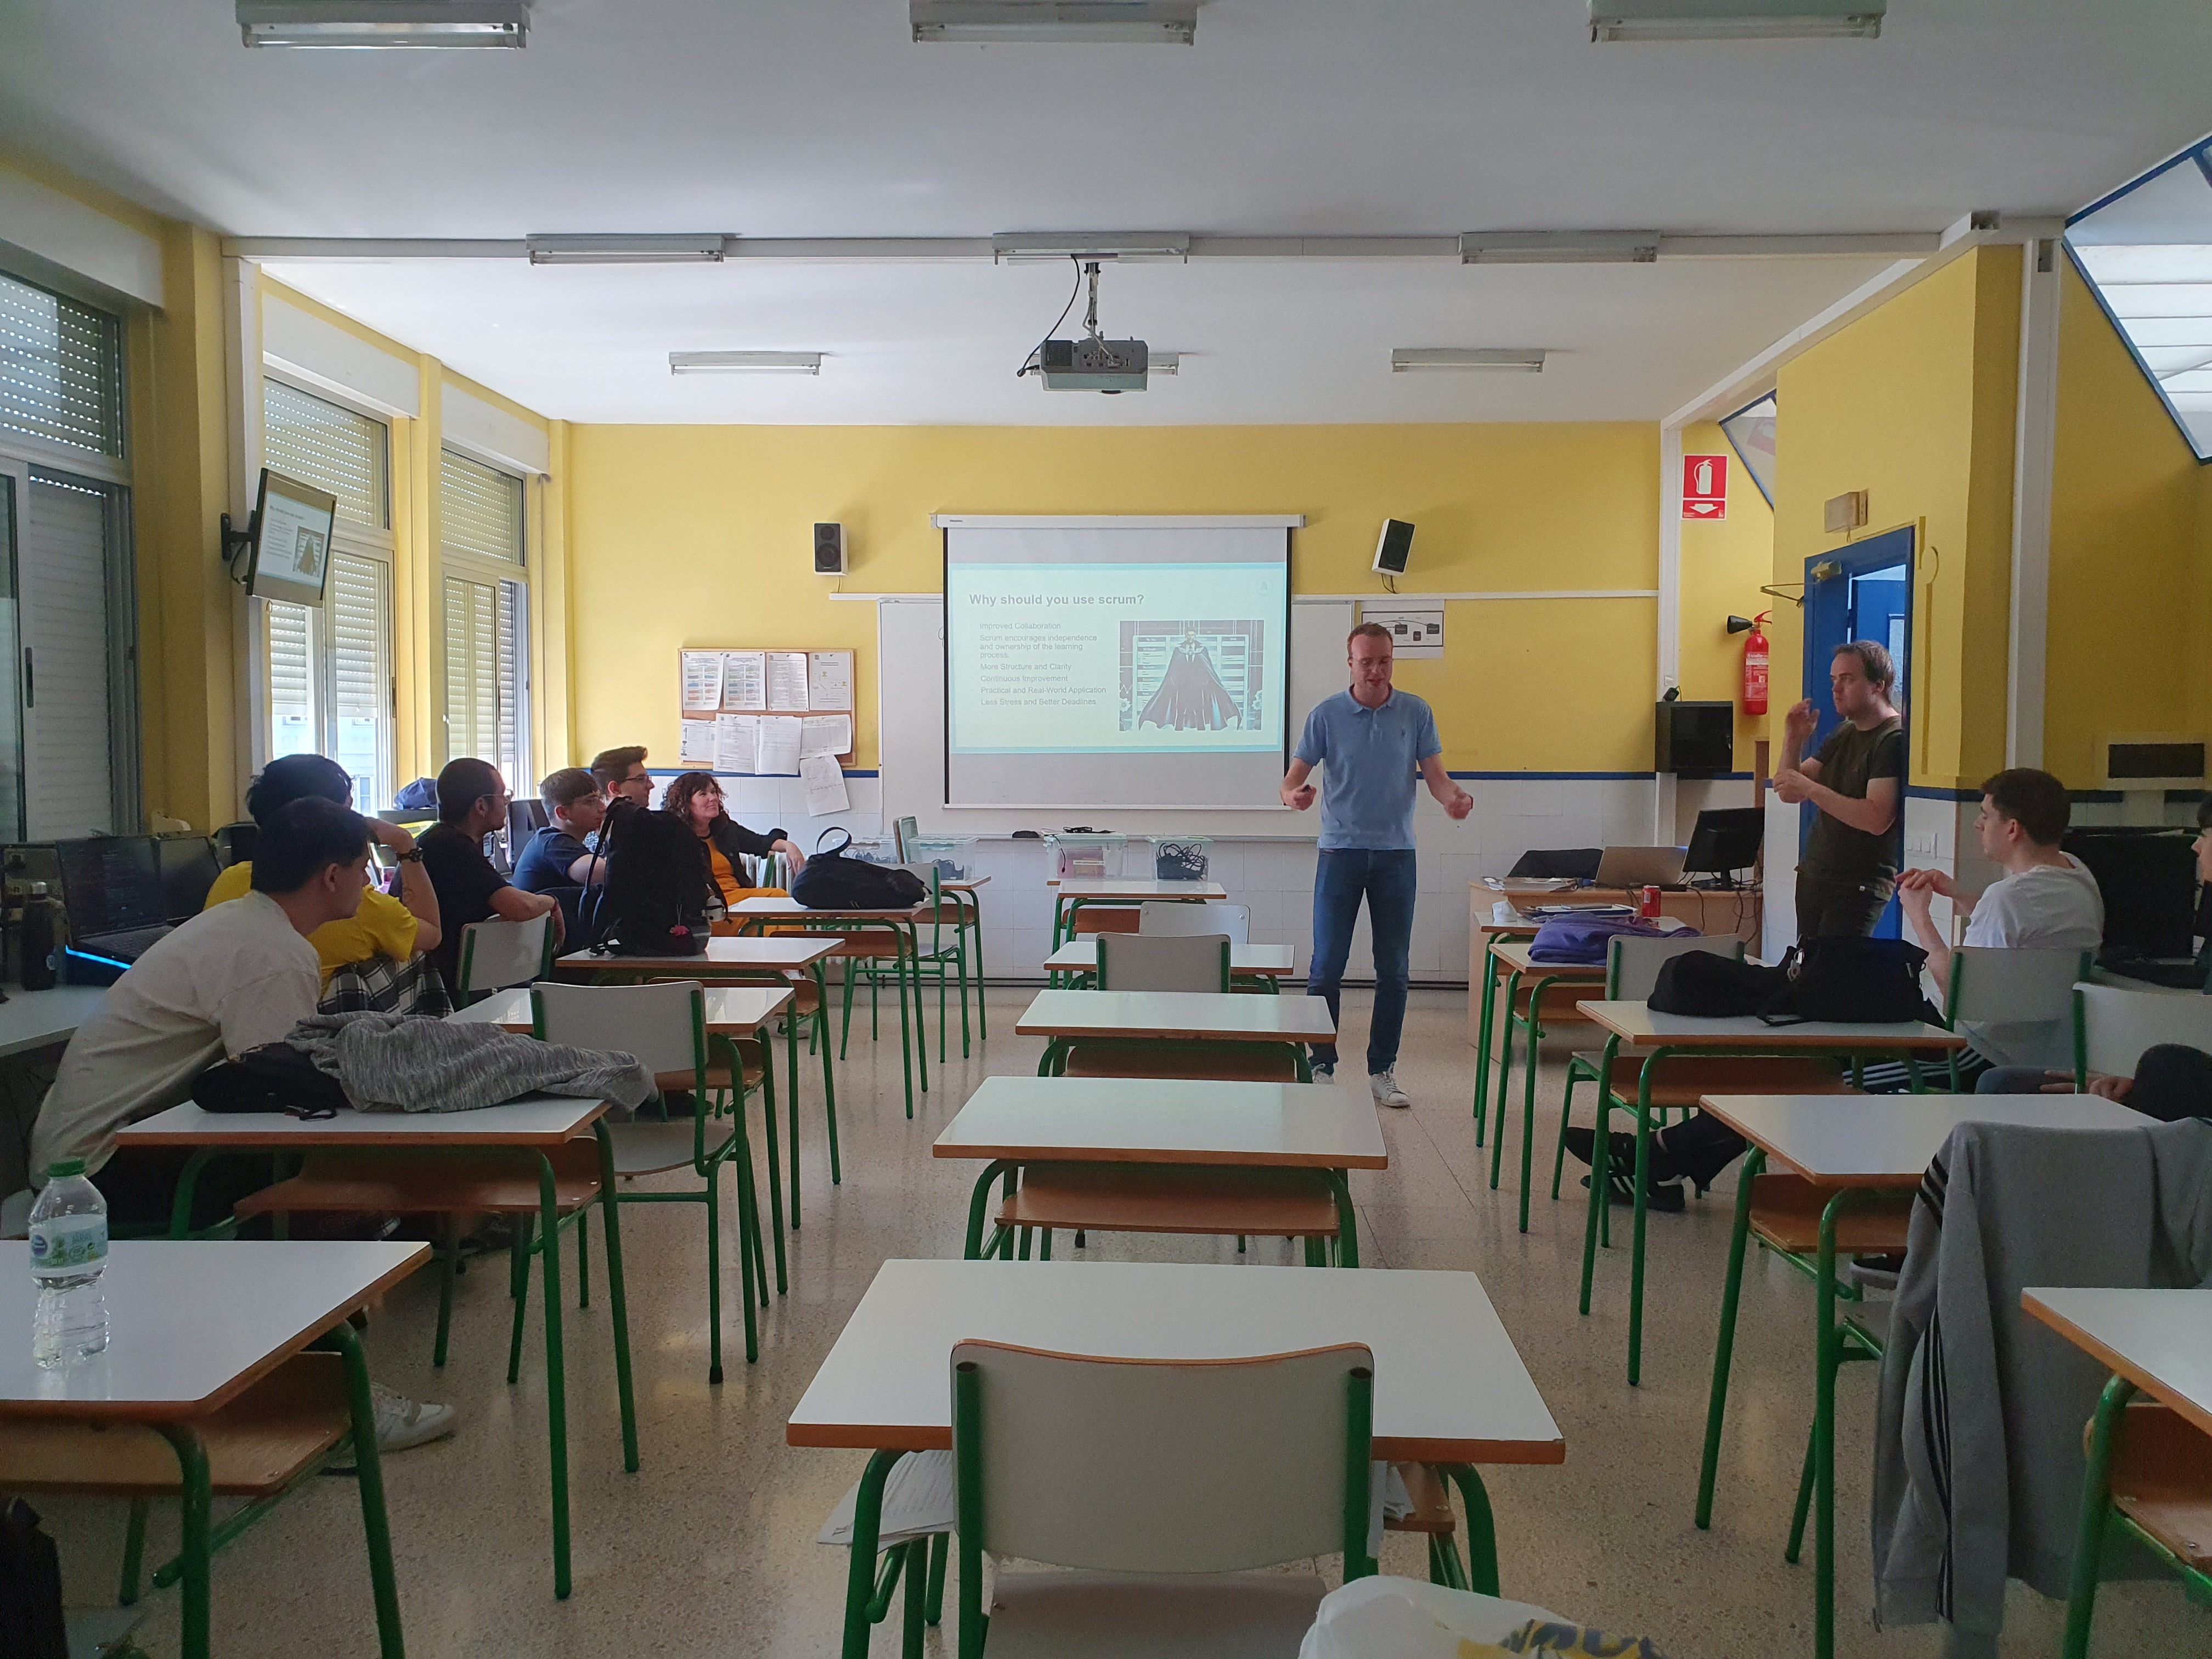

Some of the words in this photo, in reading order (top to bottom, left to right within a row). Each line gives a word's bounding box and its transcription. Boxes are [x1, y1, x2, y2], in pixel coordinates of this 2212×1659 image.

[969, 594, 996, 606] Why
[1001, 594, 1042, 604] should
[1046, 597, 1069, 606] you
[1099, 595, 1144, 604] scrum?
